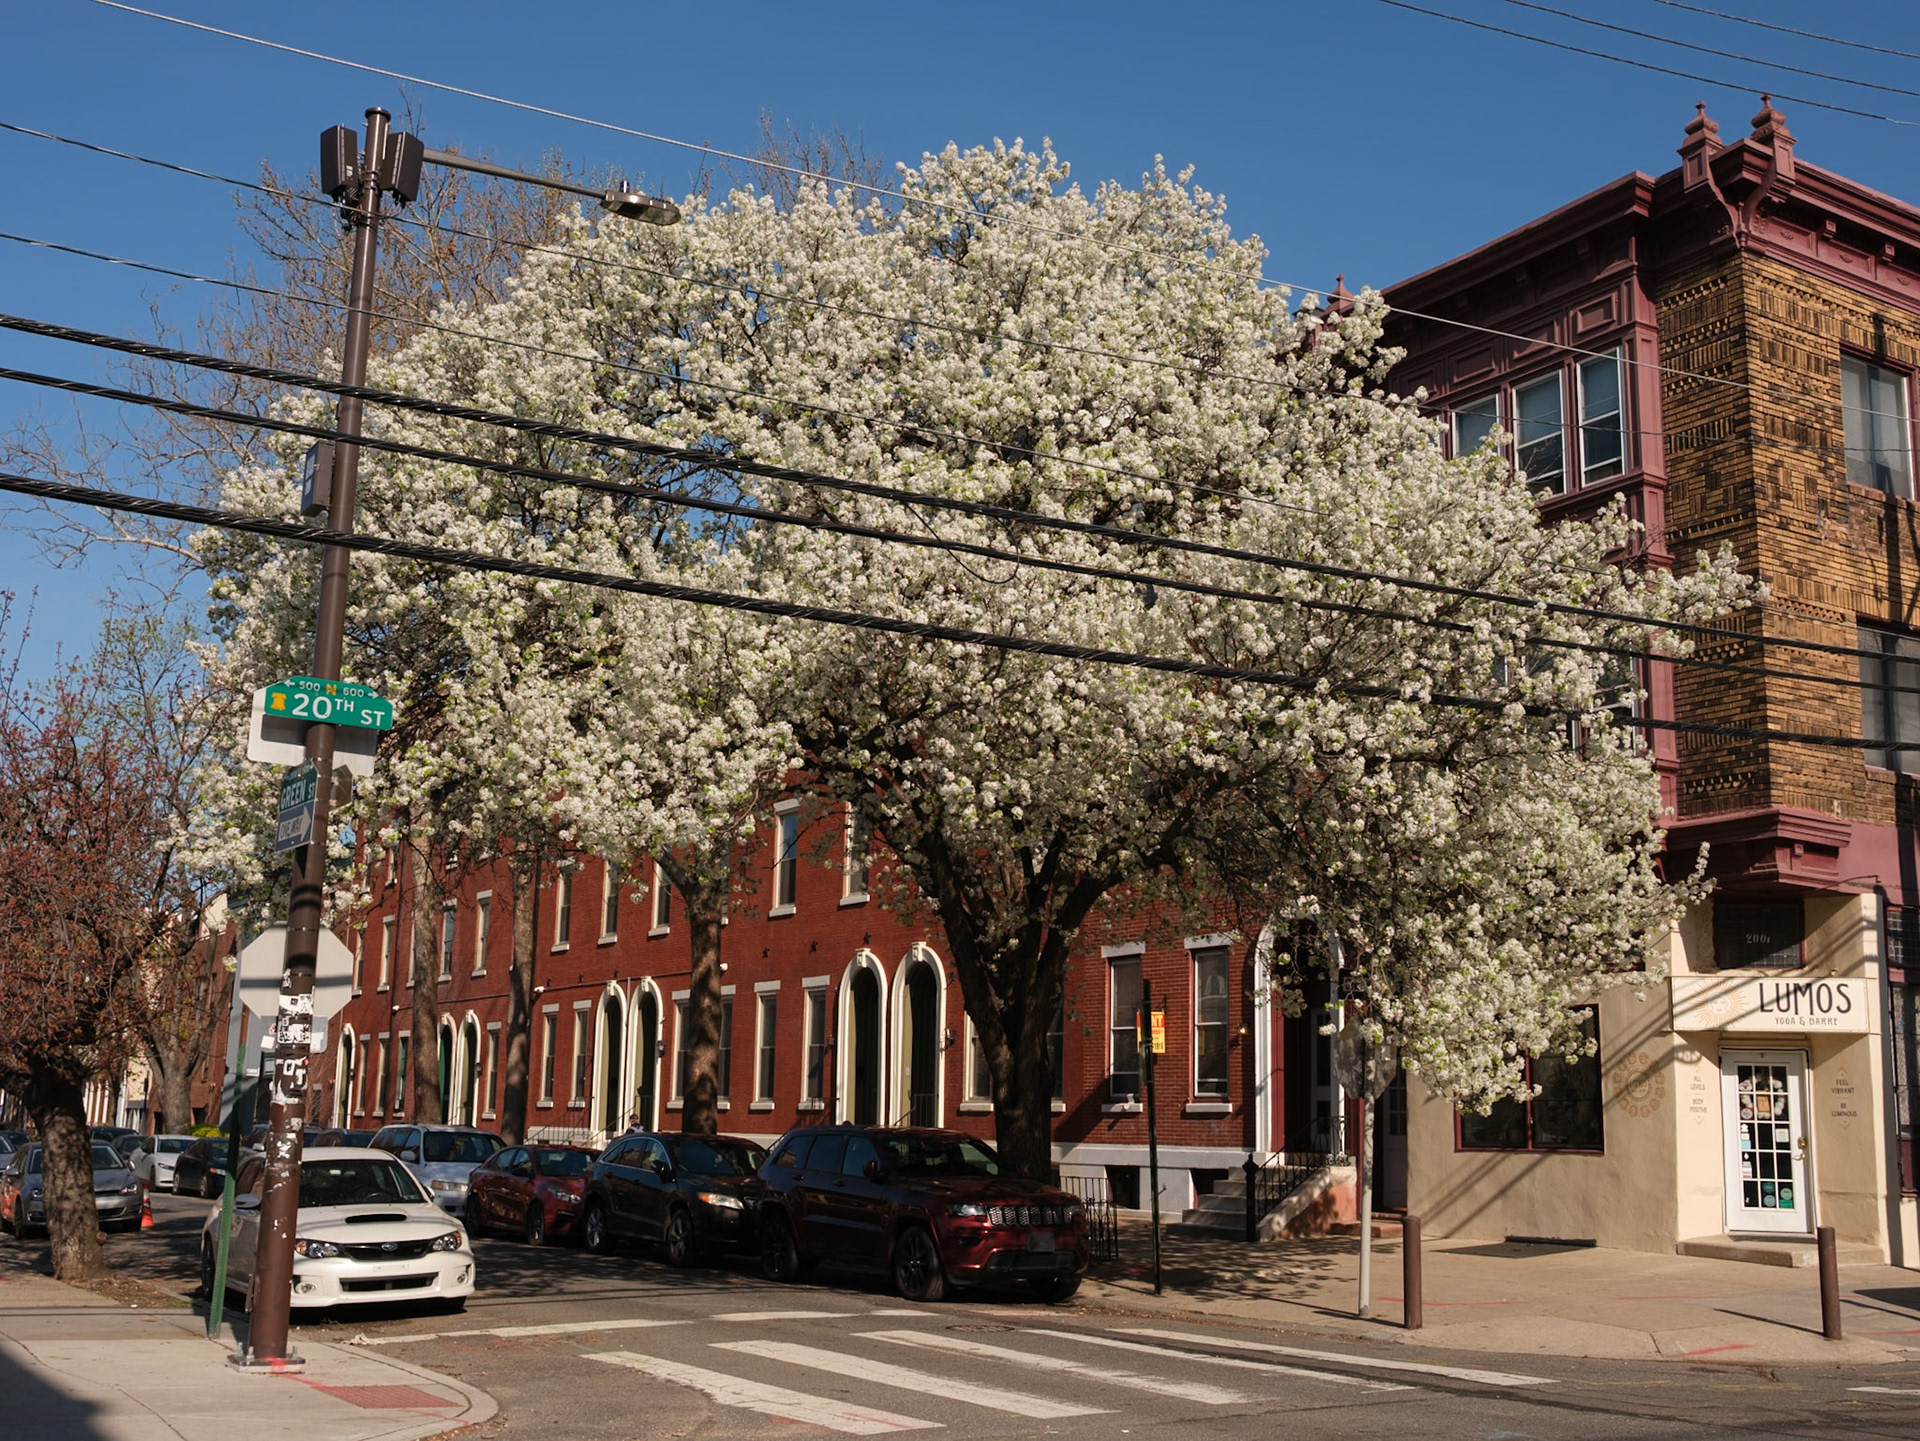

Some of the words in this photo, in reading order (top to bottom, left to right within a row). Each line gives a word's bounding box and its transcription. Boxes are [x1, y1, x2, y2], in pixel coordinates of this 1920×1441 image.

[299, 681, 321, 692] 500
[325, 683, 337, 696] N
[343, 687, 365, 698] 600
[291, 693, 355, 720] 20TH
[360, 709, 385, 727] ST
[281, 780, 307, 810] GREEN
[307, 782, 316, 799] ST
[1758, 983, 1852, 1015] LUMOS
[1775, 1017, 1796, 1025] YOGA
[1799, 1016, 1806, 1027] &
[1809, 1017, 1838, 1026] BARRE
